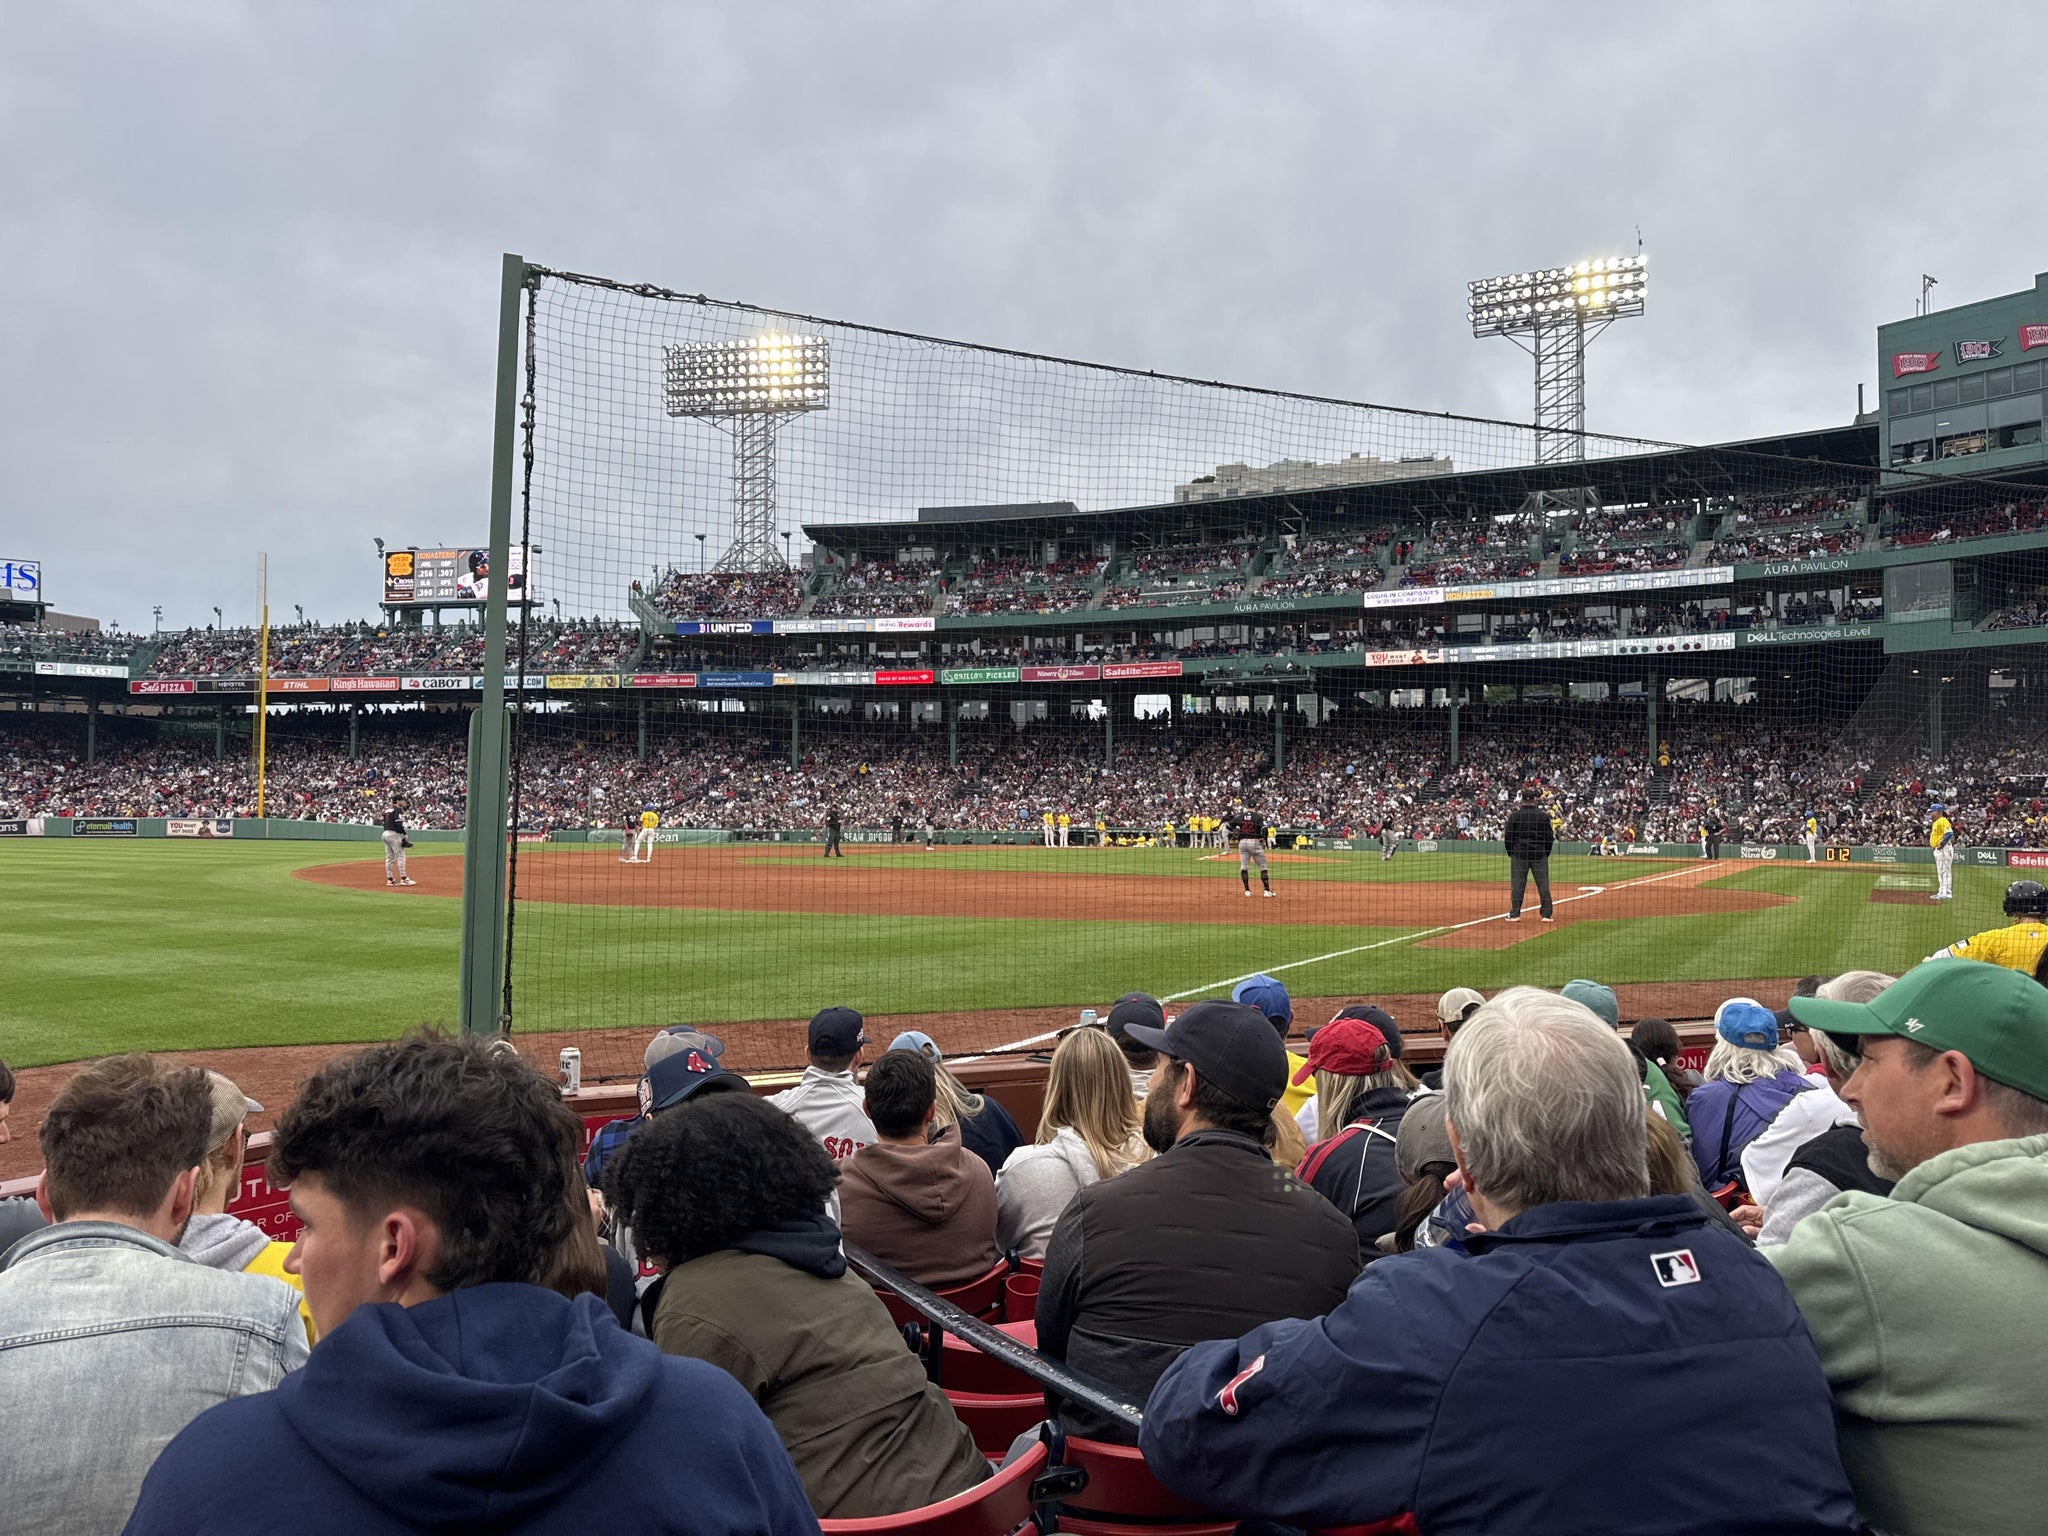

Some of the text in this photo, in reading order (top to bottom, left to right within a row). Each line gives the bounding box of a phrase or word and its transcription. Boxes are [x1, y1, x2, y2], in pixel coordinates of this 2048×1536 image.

[1960, 343, 1990, 356] 1904
[1800, 560, 1849, 572] PAVILION
[417, 569, 454, 578] .256 .307
[417, 589, 433, 597] .390
[437, 588, 454, 596] .697
[1397, 589, 1440, 598] COMPANIES
[1259, 601, 1295, 610] PAVILION
[711, 623, 752, 633] UNITED
[898, 621, 932, 629] Rewards
[1747, 626, 1871, 643] DELL Technologies Level
[1653, 637, 1677, 645] STRIKE
[1711, 636, 1731, 647] 7TH
[986, 671, 1016, 679] PICKLES
[1105, 667, 1141, 677] Safelite
[160, 683, 185, 692] PIZZA
[283, 681, 309, 689] STIHL
[333, 679, 396, 690] King's Hawaiian
[1241, 820, 1255, 833] 22
[1626, 844, 1659, 854] Franklin
[1977, 851, 1997, 860] DELL
[1676, 1055, 1703, 1070] ON!
[274, 1211, 294, 1224] OF
